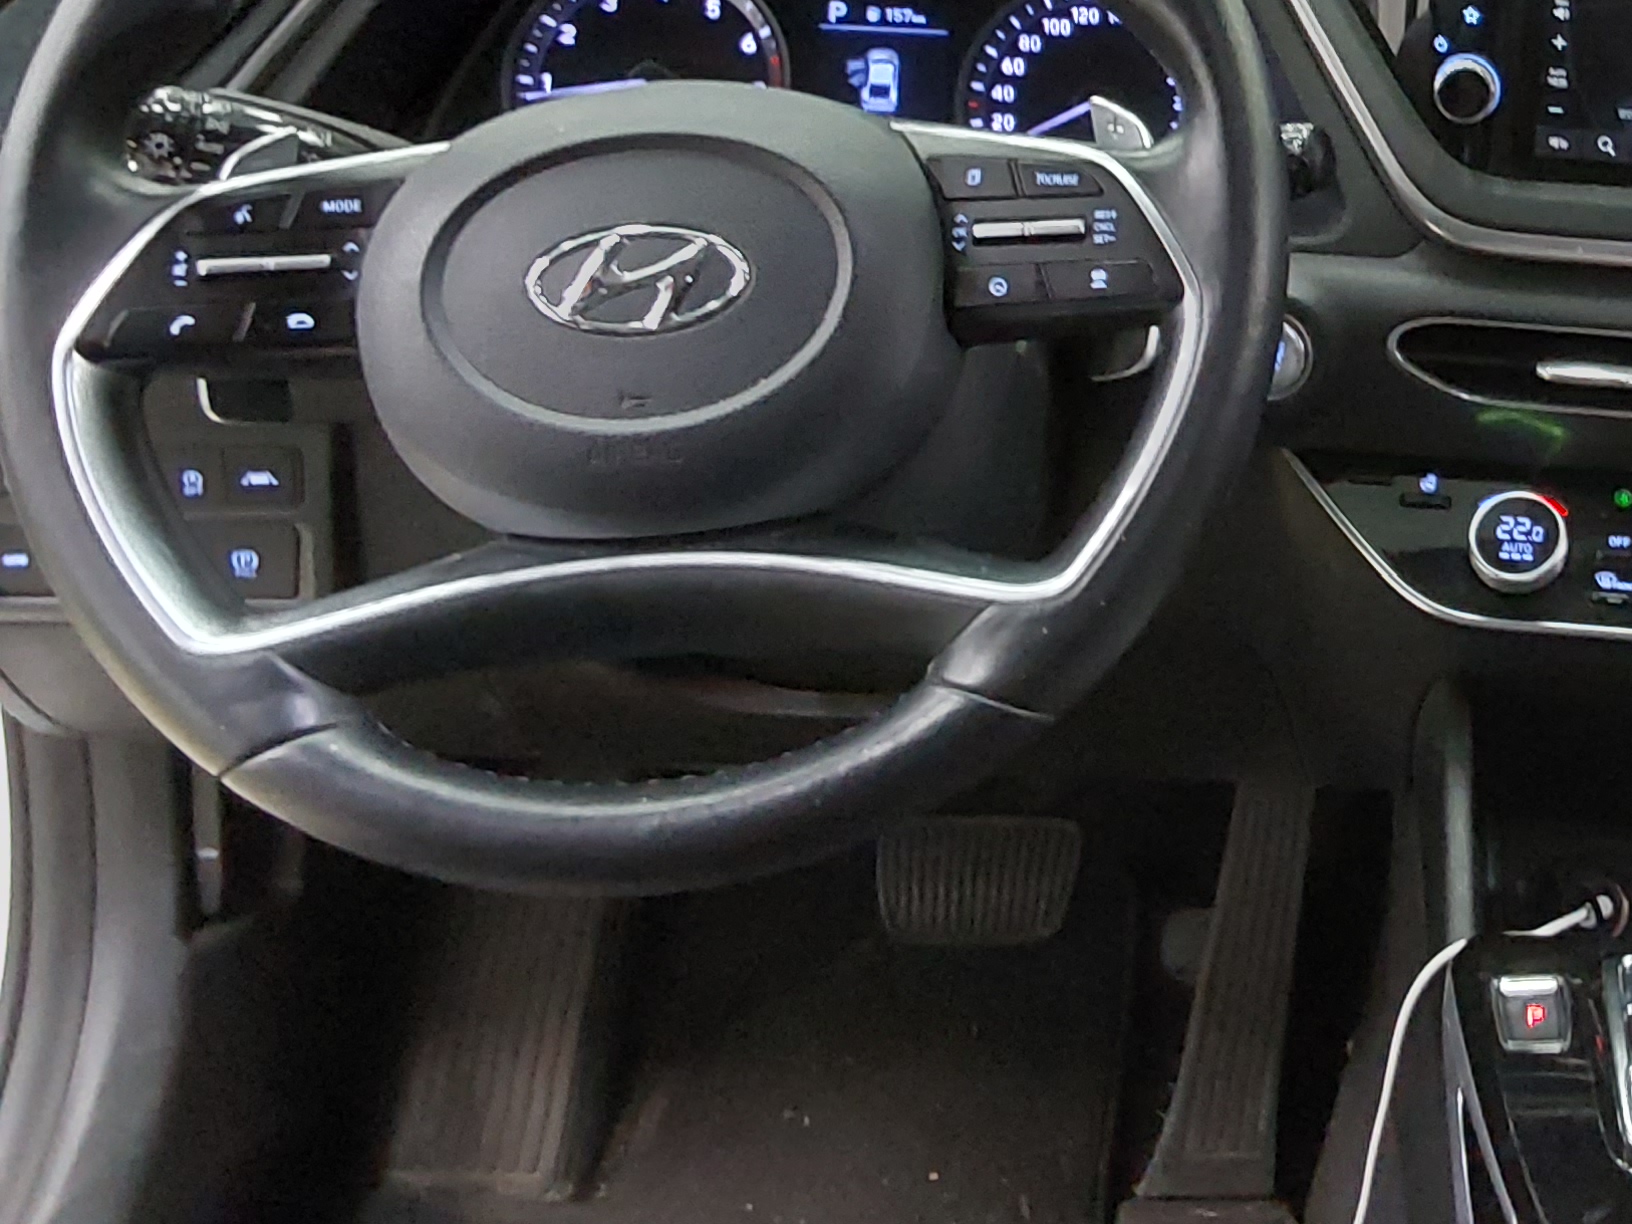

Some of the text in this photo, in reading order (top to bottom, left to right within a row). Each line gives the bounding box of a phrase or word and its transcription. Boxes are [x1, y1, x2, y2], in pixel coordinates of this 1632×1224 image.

[828, 0, 848, 24] P
[1070, 6, 1100, 26] 120
[556, 23, 577, 46] 2
[1041, 17, 1071, 37] 100
[739, 32, 757, 55] 6
[1018, 34, 1042, 53] 80
[1000, 56, 1025, 77] 60
[991, 84, 1015, 104] 40
[991, 112, 1015, 132] 20
[321, 199, 362, 213] MODE
[1496, 515, 1545, 543] 22.0
[1501, 542, 1534, 554] AUTO
[1525, 1003, 1547, 1028] P
